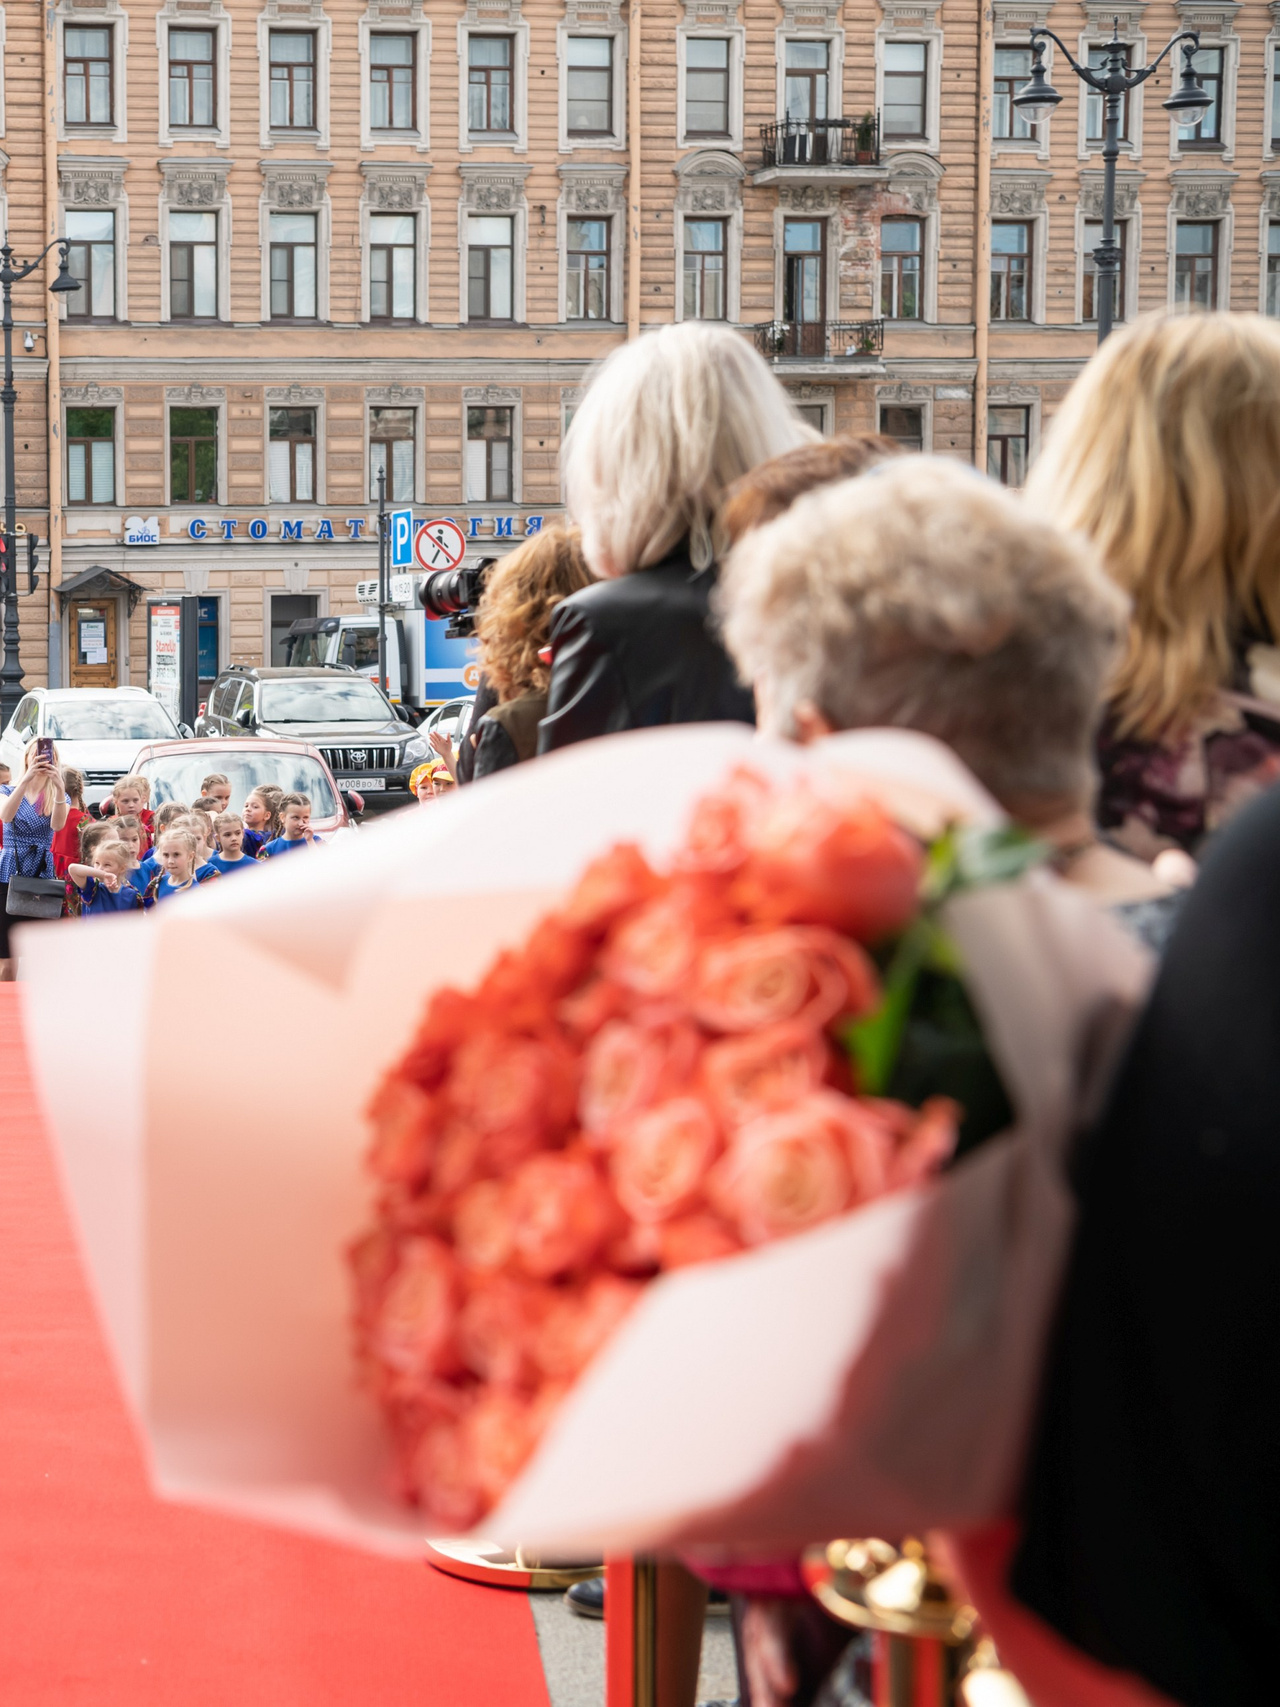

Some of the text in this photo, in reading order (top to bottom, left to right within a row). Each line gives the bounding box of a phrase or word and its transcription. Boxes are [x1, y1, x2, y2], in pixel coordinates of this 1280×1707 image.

[128, 534, 157, 543] БИОС
[188, 516, 544, 540] СТОМАТГИЯ
[396, 516, 410, 561] P
